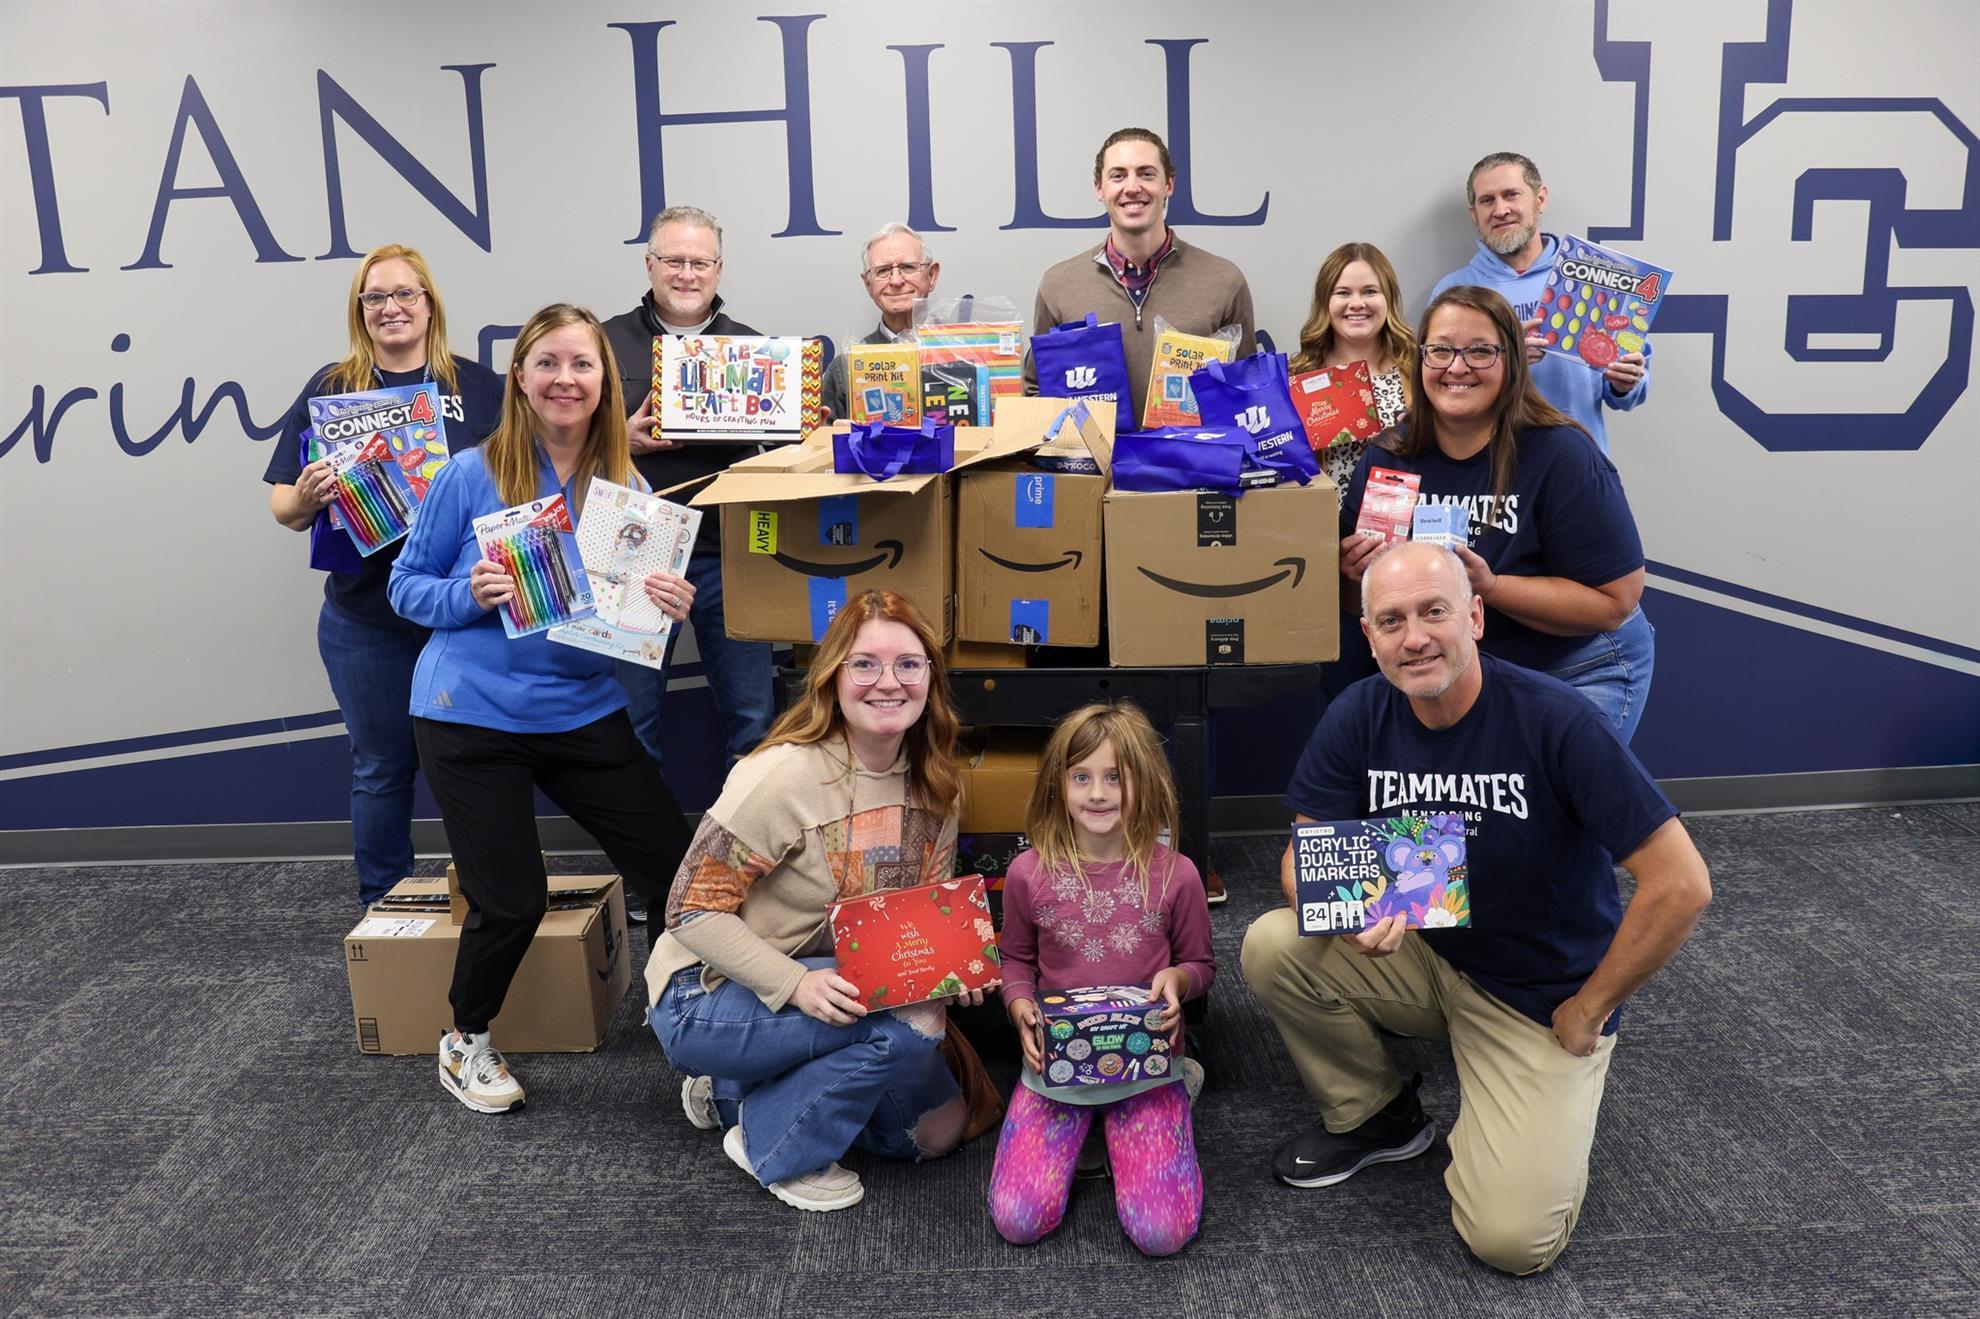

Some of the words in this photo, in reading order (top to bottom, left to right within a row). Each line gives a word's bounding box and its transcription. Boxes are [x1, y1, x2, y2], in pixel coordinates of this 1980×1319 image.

[0, 63, 497, 275] TAN
[607, 14, 1269, 245] HILL
[1562, 261, 1641, 293] CONNECT
[1636, 275, 1660, 304] 4
[746, 393, 786, 416] BOX
[323, 406, 412, 440] CONNECT
[411, 391, 434, 425] 4
[685, 413, 710, 423] HOURS
[713, 414, 722, 422] OF
[723, 415, 757, 425] CRAFTING
[760, 417, 776, 426] FUN
[1257, 430, 1294, 451] ESTERN
[1033, 476, 1044, 505] prime
[476, 522, 504, 536] Paper
[757, 512, 770, 552] HEAVY
[580, 592, 591, 600] 20
[1368, 769, 1528, 820] TEAMMATES
[1300, 836, 1371, 853] ACRYLIC
[1301, 851, 1377, 868] DUAL-TIP
[1301, 864, 1380, 883] MARKERS
[1306, 908, 1327, 922] 24
[891, 946, 935, 962] Christmas
[1092, 1034, 1126, 1047] GLOW
